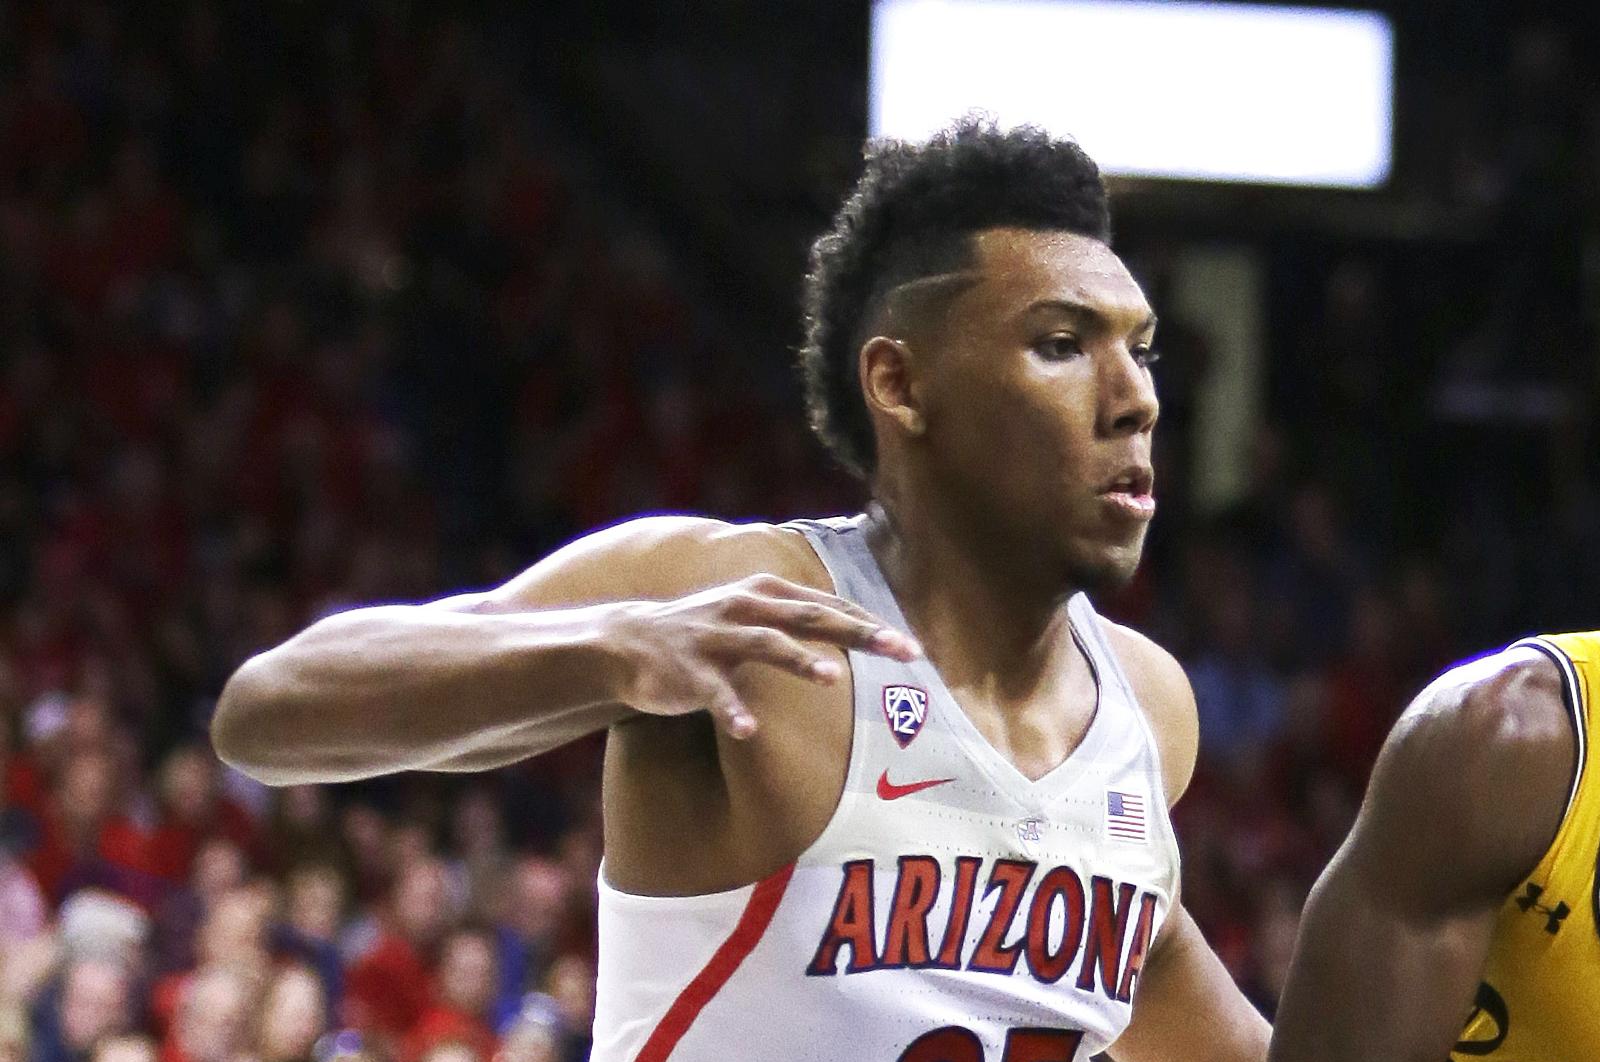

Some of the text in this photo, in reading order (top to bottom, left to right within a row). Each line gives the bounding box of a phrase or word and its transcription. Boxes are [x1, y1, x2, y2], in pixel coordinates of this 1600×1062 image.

[885, 686, 927, 723] PAC
[893, 710, 917, 734] 12
[804, 855, 1158, 1004] ARIZONA
